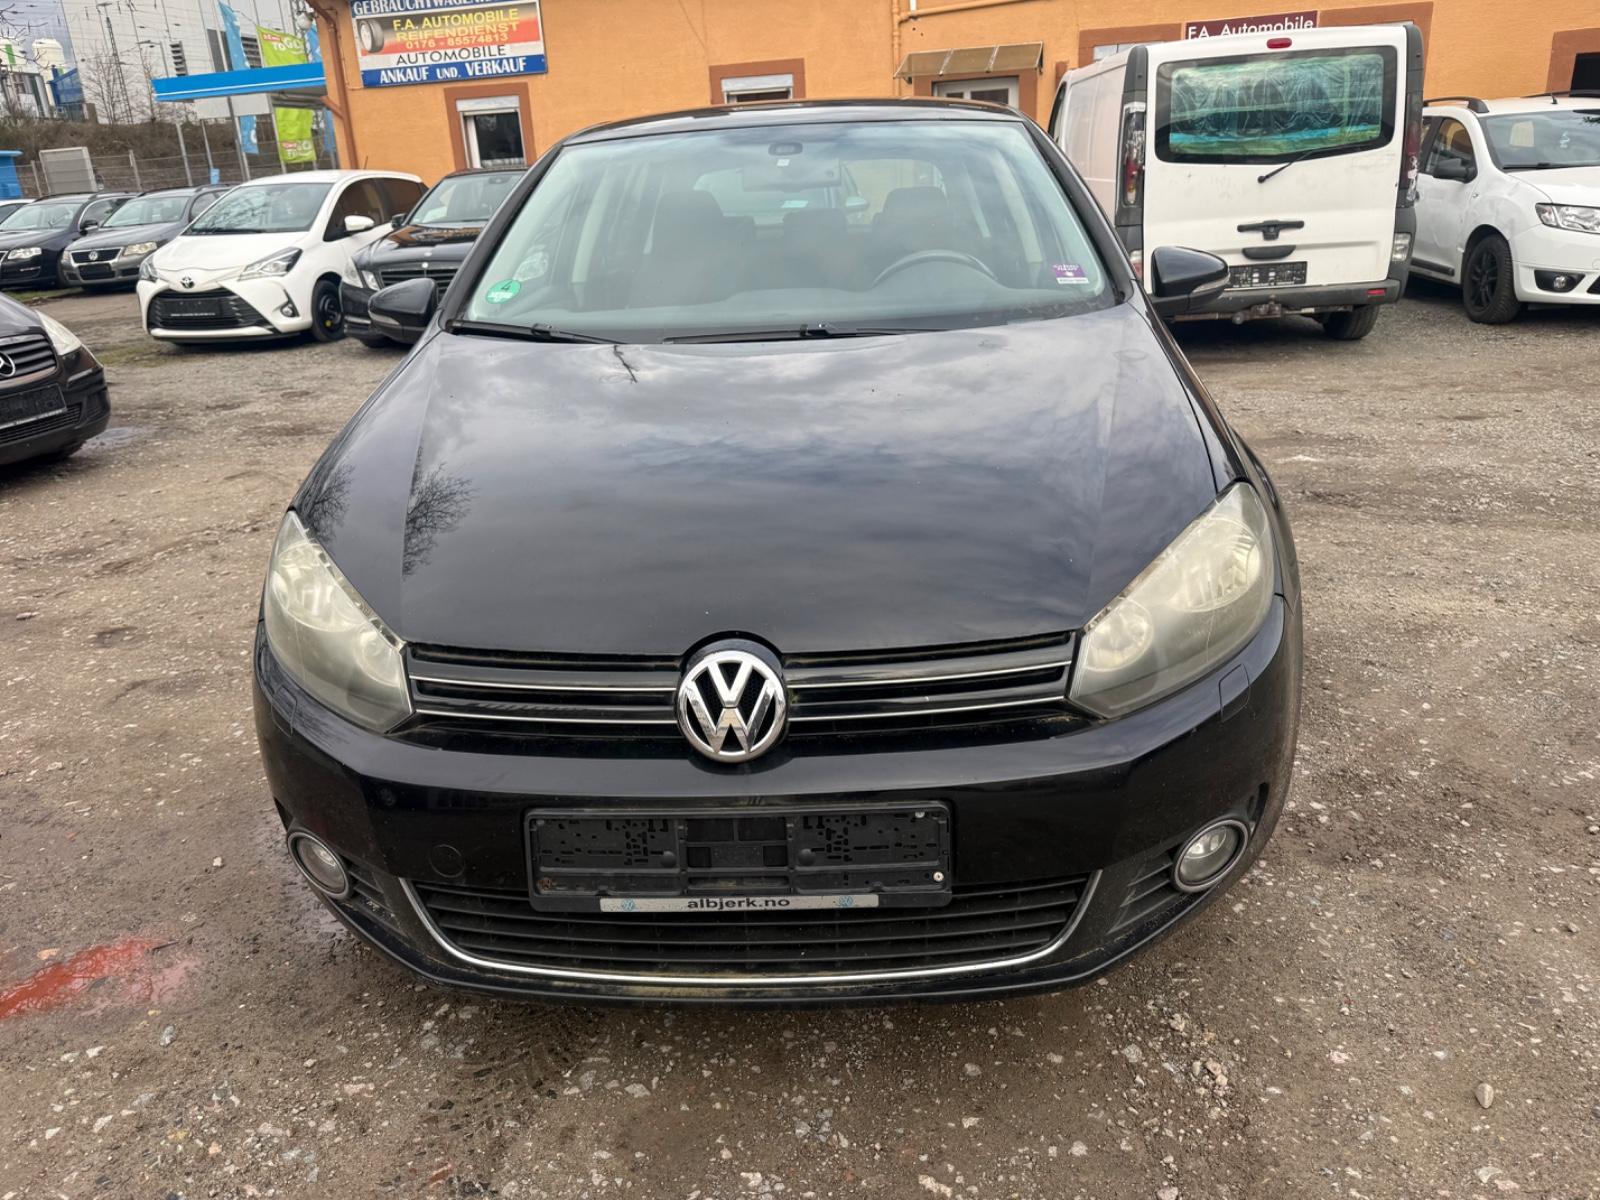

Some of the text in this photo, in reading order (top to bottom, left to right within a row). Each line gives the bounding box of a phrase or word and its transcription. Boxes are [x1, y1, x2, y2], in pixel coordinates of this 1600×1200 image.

[393, 8, 519, 31] F.A. AUTOMOBILE
[1220, 16, 1314, 36] Automobile
[396, 21, 519, 42] REIFENDIENST
[405, 37, 436, 49] 0176
[396, 44, 507, 66] AUTOMOBILE
[380, 66, 430, 84] ANKAUF
[465, 57, 527, 76] VERKAUF
[501, 280, 513, 292] 4
[687, 898, 790, 911] albjerk.no
